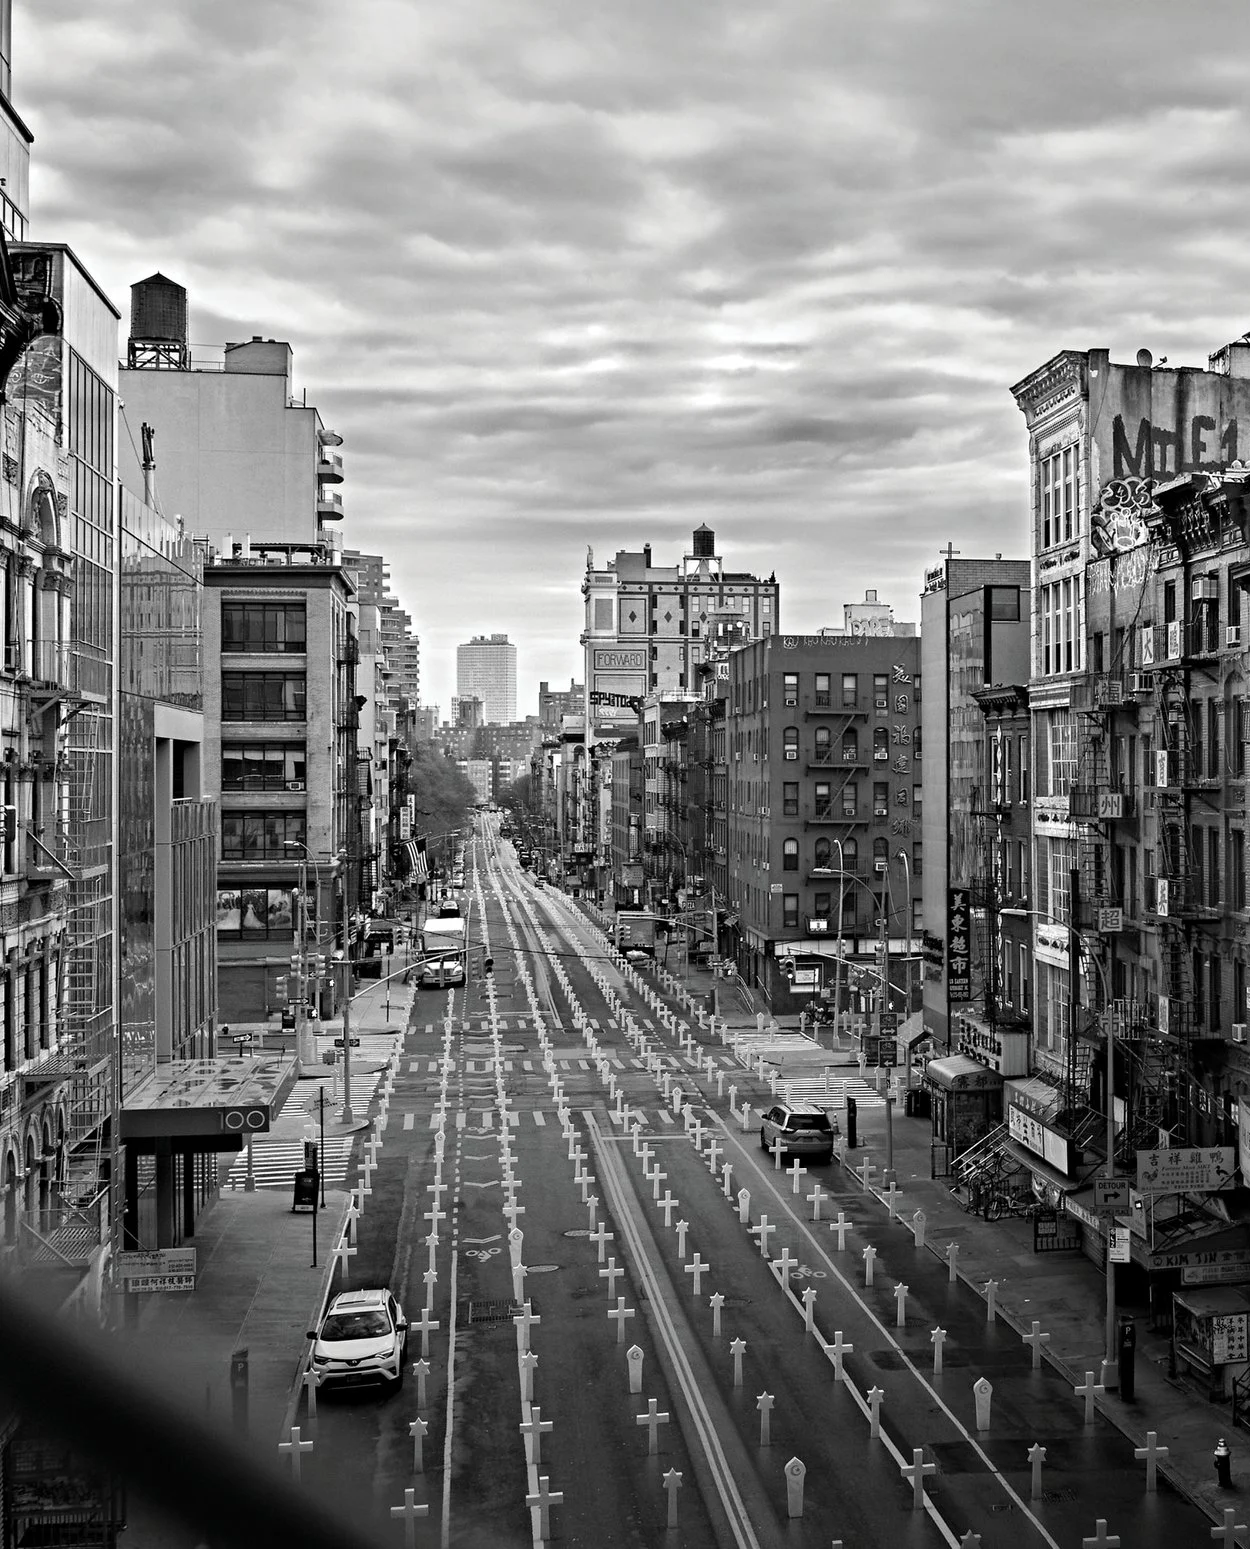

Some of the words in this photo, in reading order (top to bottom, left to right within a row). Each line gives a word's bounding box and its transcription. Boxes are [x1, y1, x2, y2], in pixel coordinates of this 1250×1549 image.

[597, 653, 643, 666] FORWARD
[1101, 795, 1121, 817] 州
[681, 901, 696, 909] PZZA
[1100, 910, 1120, 930] 超
[950, 892, 968, 975] 美東超市
[218, 1110, 266, 1129] 100
[1098, 1182, 1126, 1190] DETOUR
[1166, 1255, 1189, 1265] KIM
[1197, 1253, 1217, 1264] TIN
